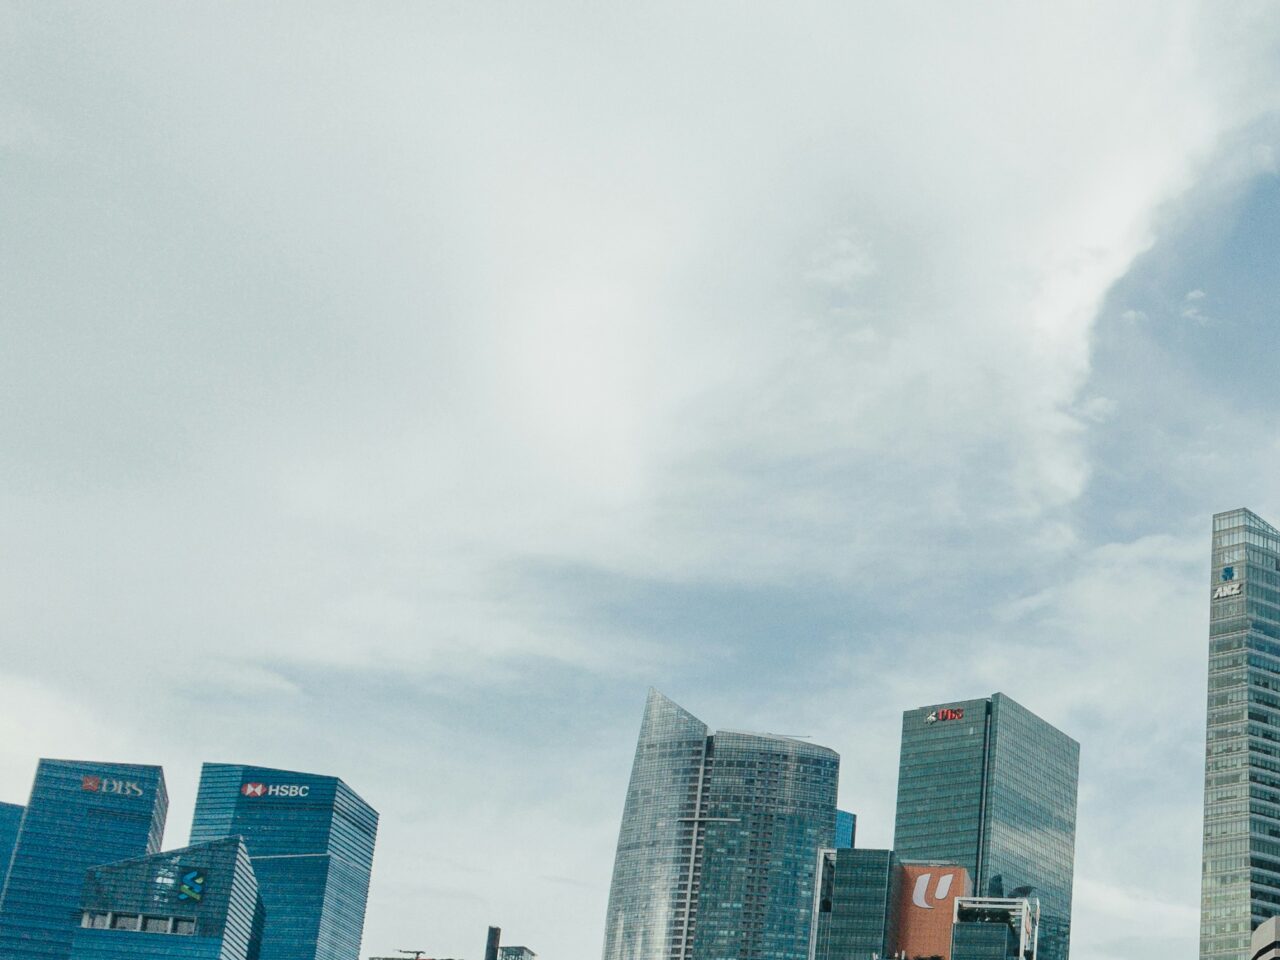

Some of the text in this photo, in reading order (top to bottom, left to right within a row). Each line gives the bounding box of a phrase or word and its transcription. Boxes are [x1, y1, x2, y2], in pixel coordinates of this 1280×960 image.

[1213, 583, 1242, 599] ANZ
[101, 778, 144, 797] DBS
[268, 784, 310, 797] HSBC
